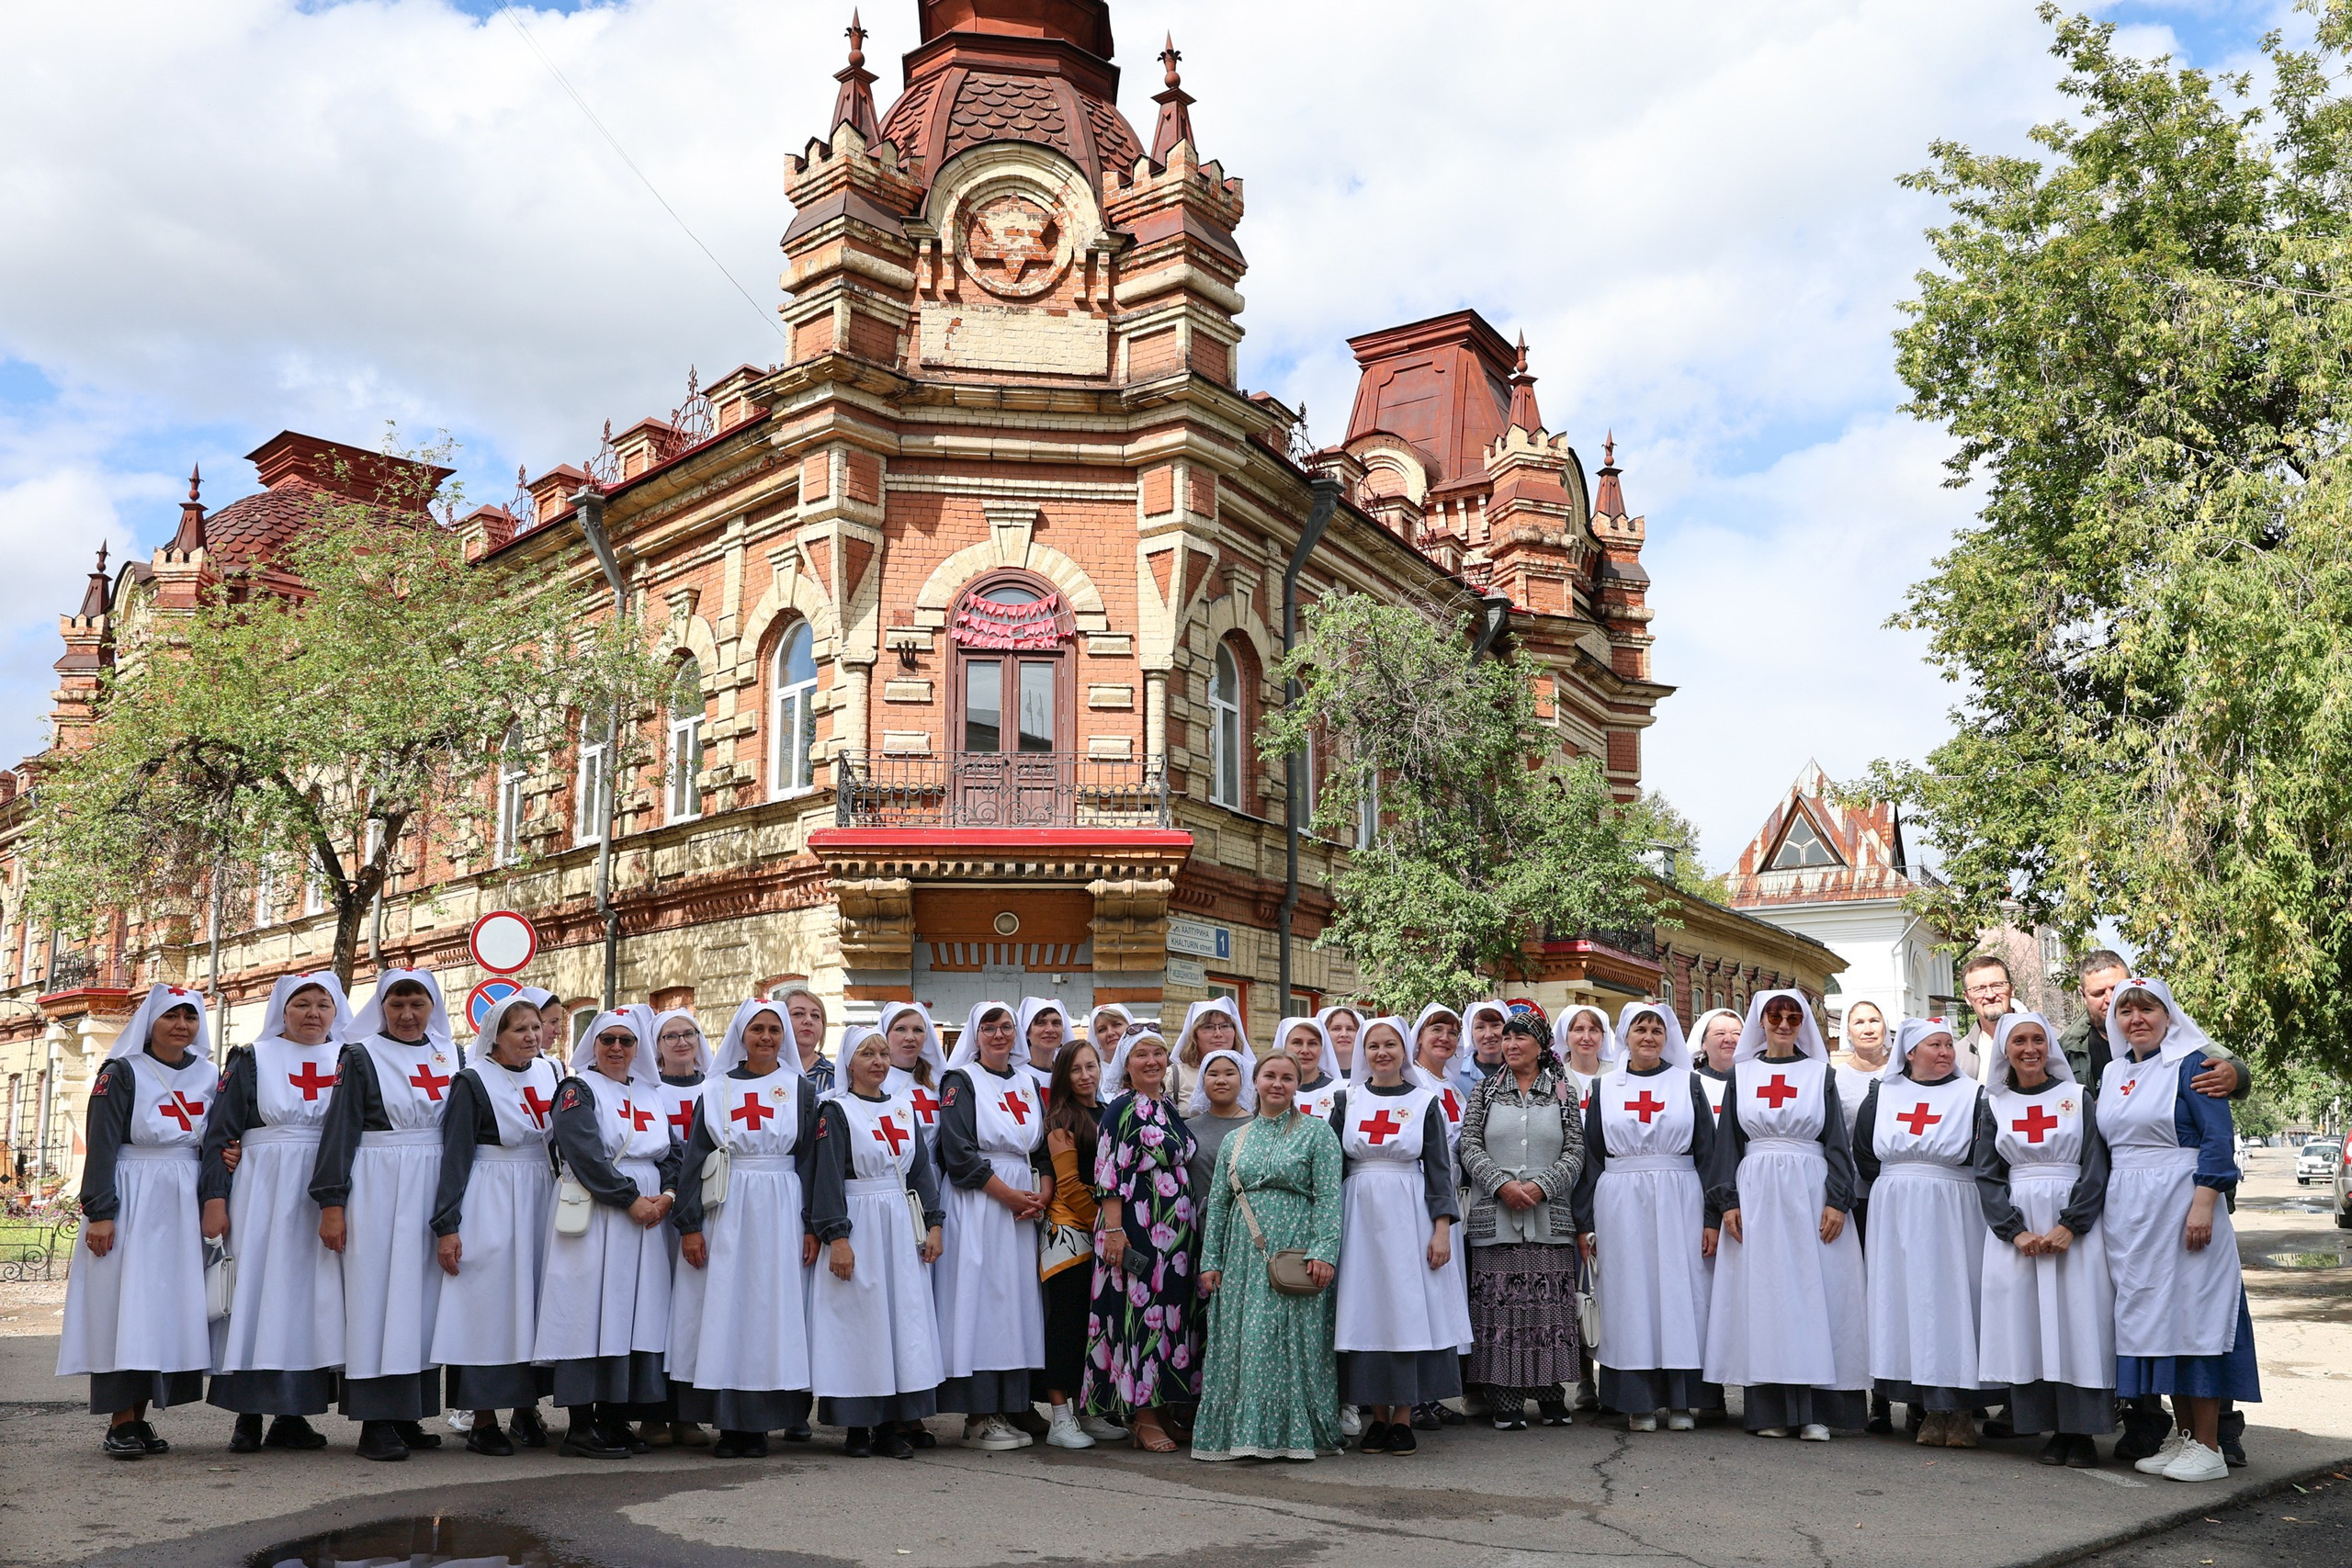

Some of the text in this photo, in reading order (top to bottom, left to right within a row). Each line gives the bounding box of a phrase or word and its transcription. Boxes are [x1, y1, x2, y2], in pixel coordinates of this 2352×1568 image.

[1182, 925, 1210, 938] ХАЛТУРИНА
[1170, 937, 1213, 953] KHALTURIN street
[1219, 935, 1225, 952] 1
